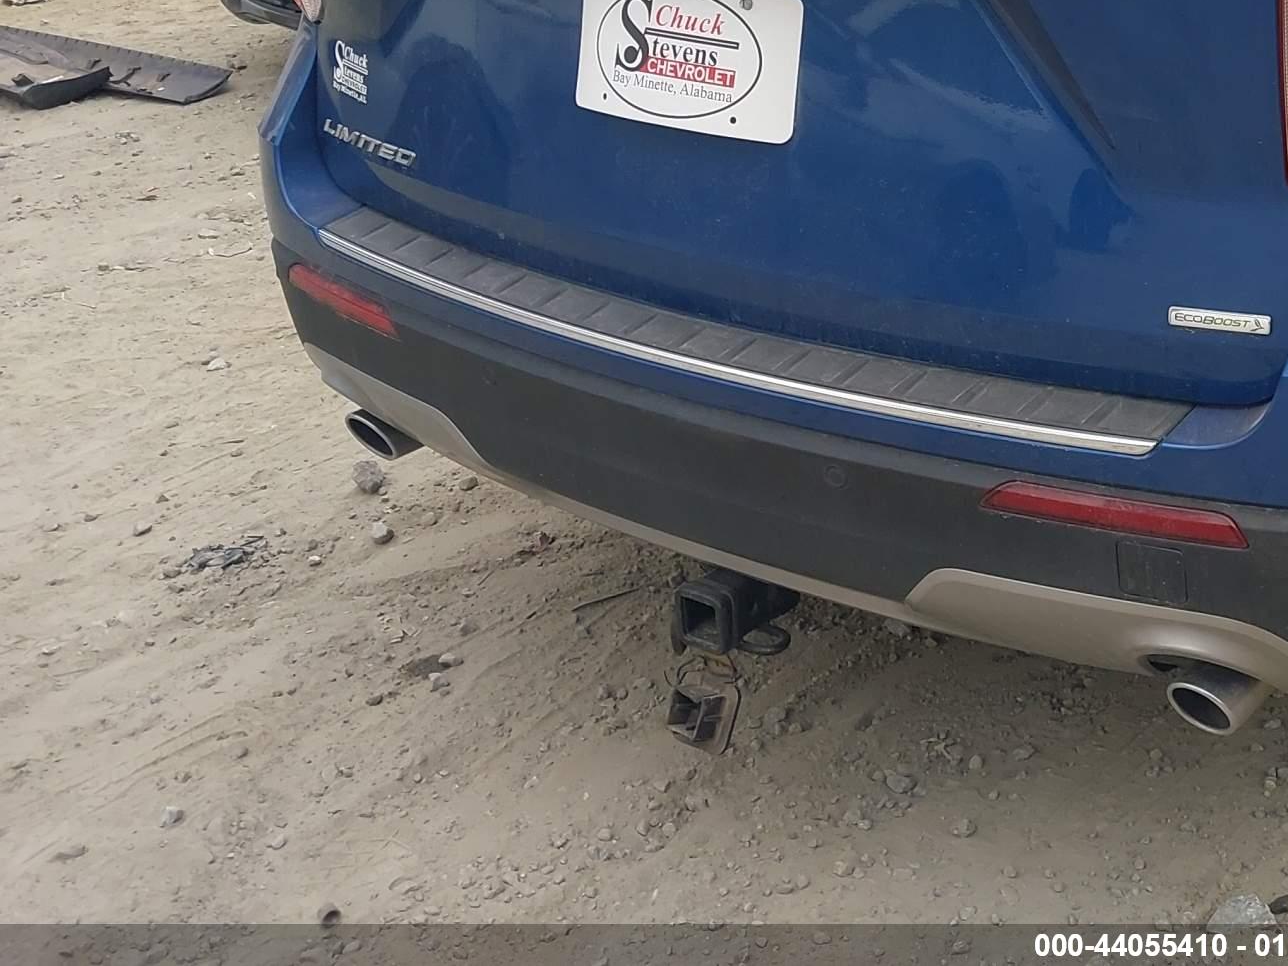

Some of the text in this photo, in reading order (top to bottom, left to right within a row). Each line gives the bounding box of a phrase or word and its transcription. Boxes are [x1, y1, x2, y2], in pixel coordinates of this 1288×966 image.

[656, 4, 725, 35] Chuck
[344, 46, 368, 68] Chuck
[647, 59, 735, 85] CHEVROLET
[613, 70, 732, 103] Bay Minette, Alabama
[323, 118, 416, 167] LIMITED
